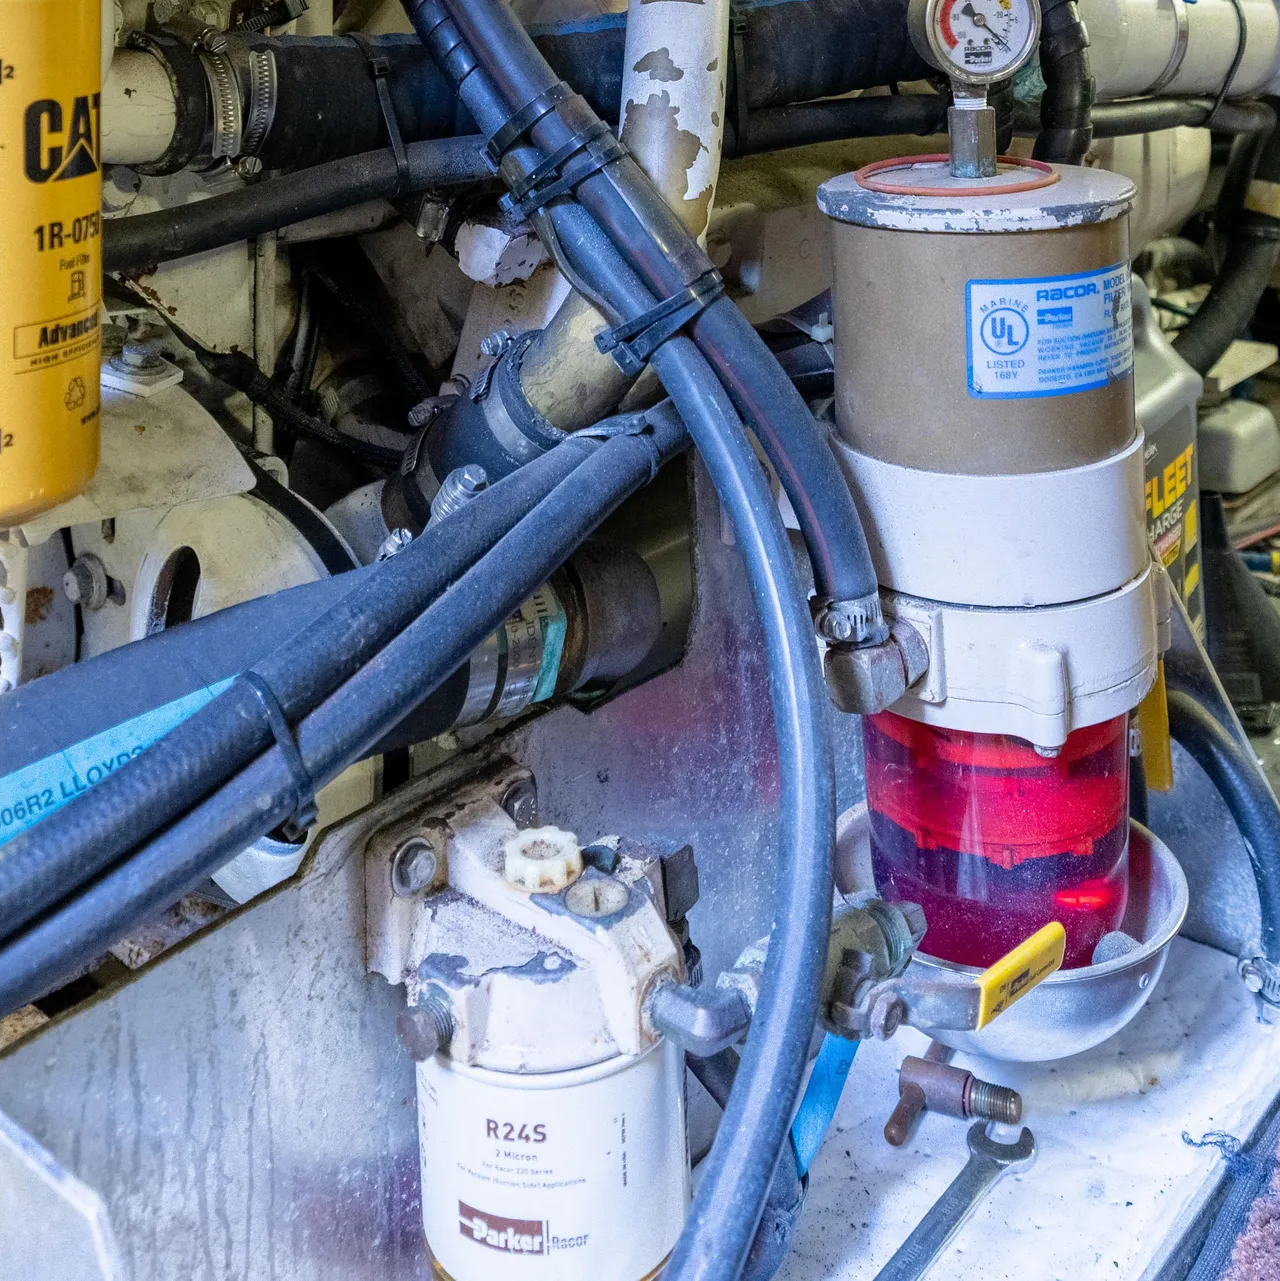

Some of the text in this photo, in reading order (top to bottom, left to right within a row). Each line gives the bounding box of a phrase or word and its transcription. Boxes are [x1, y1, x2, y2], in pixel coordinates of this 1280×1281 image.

[1103, 274, 1125, 289] MODEL
[980, 297, 1029, 314] MARINE
[991, 317, 1019, 346] UL
[30, 354, 59, 368] HIGH
[986, 359, 1025, 369] LISTED
[1147, 498, 1185, 542] HARGE
[486, 1118, 548, 1144] R24S
[495, 1149, 538, 1162] 2 Micron
[472, 1217, 544, 1252] Parker
[551, 1233, 591, 1250] Racor
